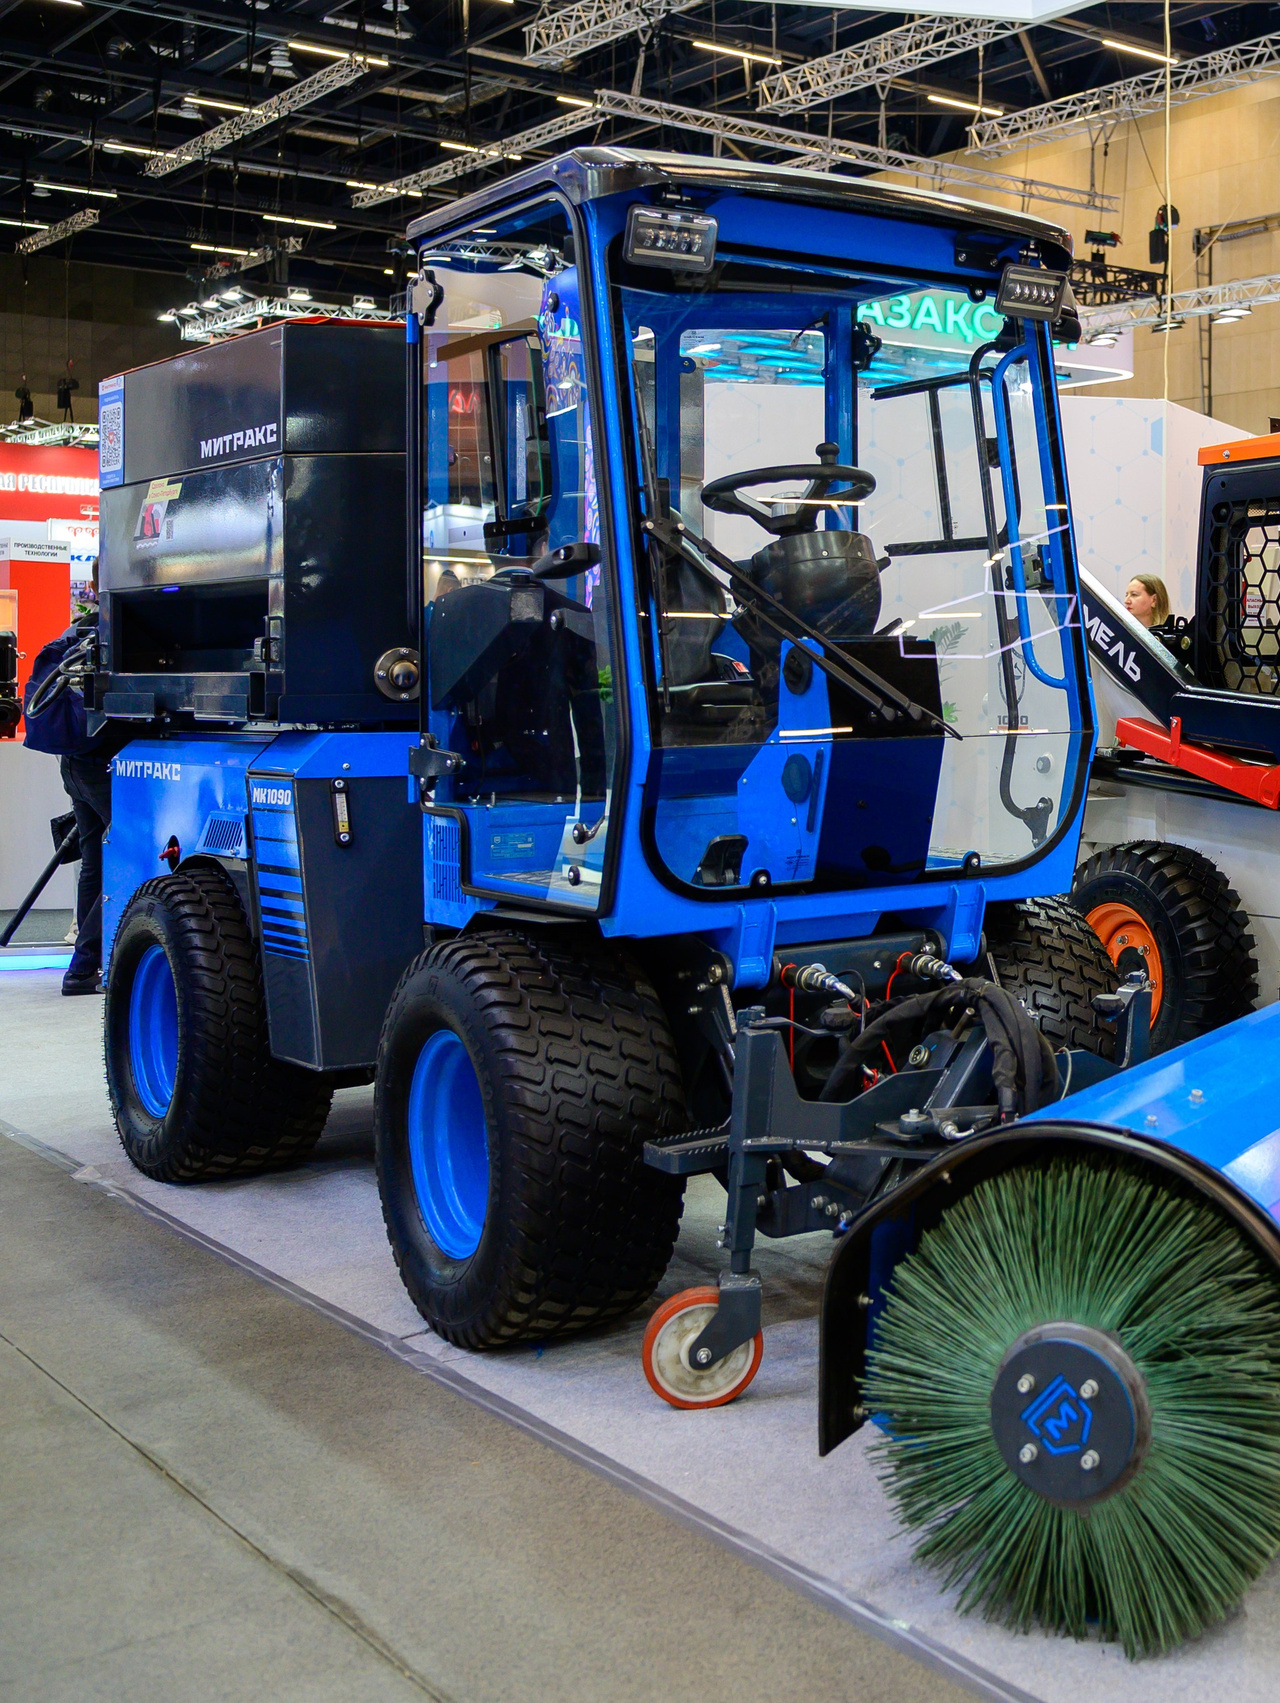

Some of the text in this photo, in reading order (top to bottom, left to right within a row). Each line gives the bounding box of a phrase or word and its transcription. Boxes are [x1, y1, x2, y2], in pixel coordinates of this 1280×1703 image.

[200, 422, 277, 459] МИТРАКС
[14, 542, 68, 551] ПРОИЗВОДСТВЕННЫЕ
[116, 761, 181, 781] МИТРАКС
[252, 787, 292, 806] МК1090
